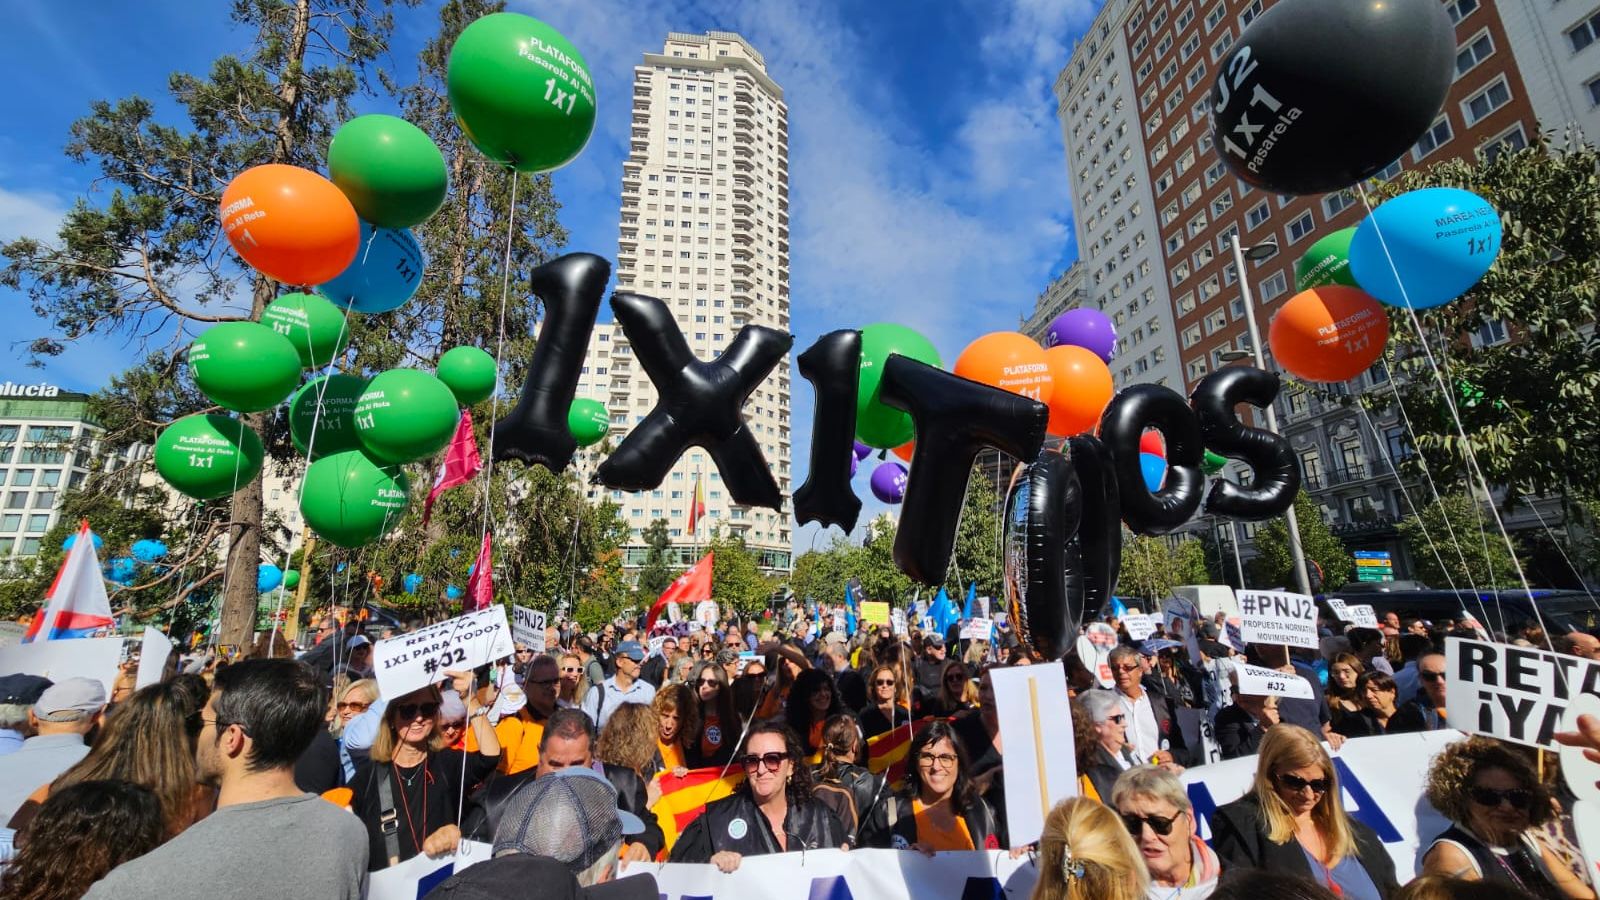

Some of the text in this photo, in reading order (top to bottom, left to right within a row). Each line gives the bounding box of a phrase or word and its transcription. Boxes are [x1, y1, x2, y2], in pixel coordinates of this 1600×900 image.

[1247, 107, 1303, 174] Pasarela
[188, 453, 214, 469] 1x1
[1242, 594, 1314, 621] #PNJ2
[513, 607, 544, 631] #PNJ2
[1243, 619, 1285, 631] PROPUESTA
[405, 628, 451, 647] RETA
[412, 639, 451, 660] PARA
[453, 621, 502, 643] TODOS
[1257, 632, 1300, 644] MOVIMIENTO
[422, 646, 468, 675] #J2
[1267, 681, 1287, 692] #J2
